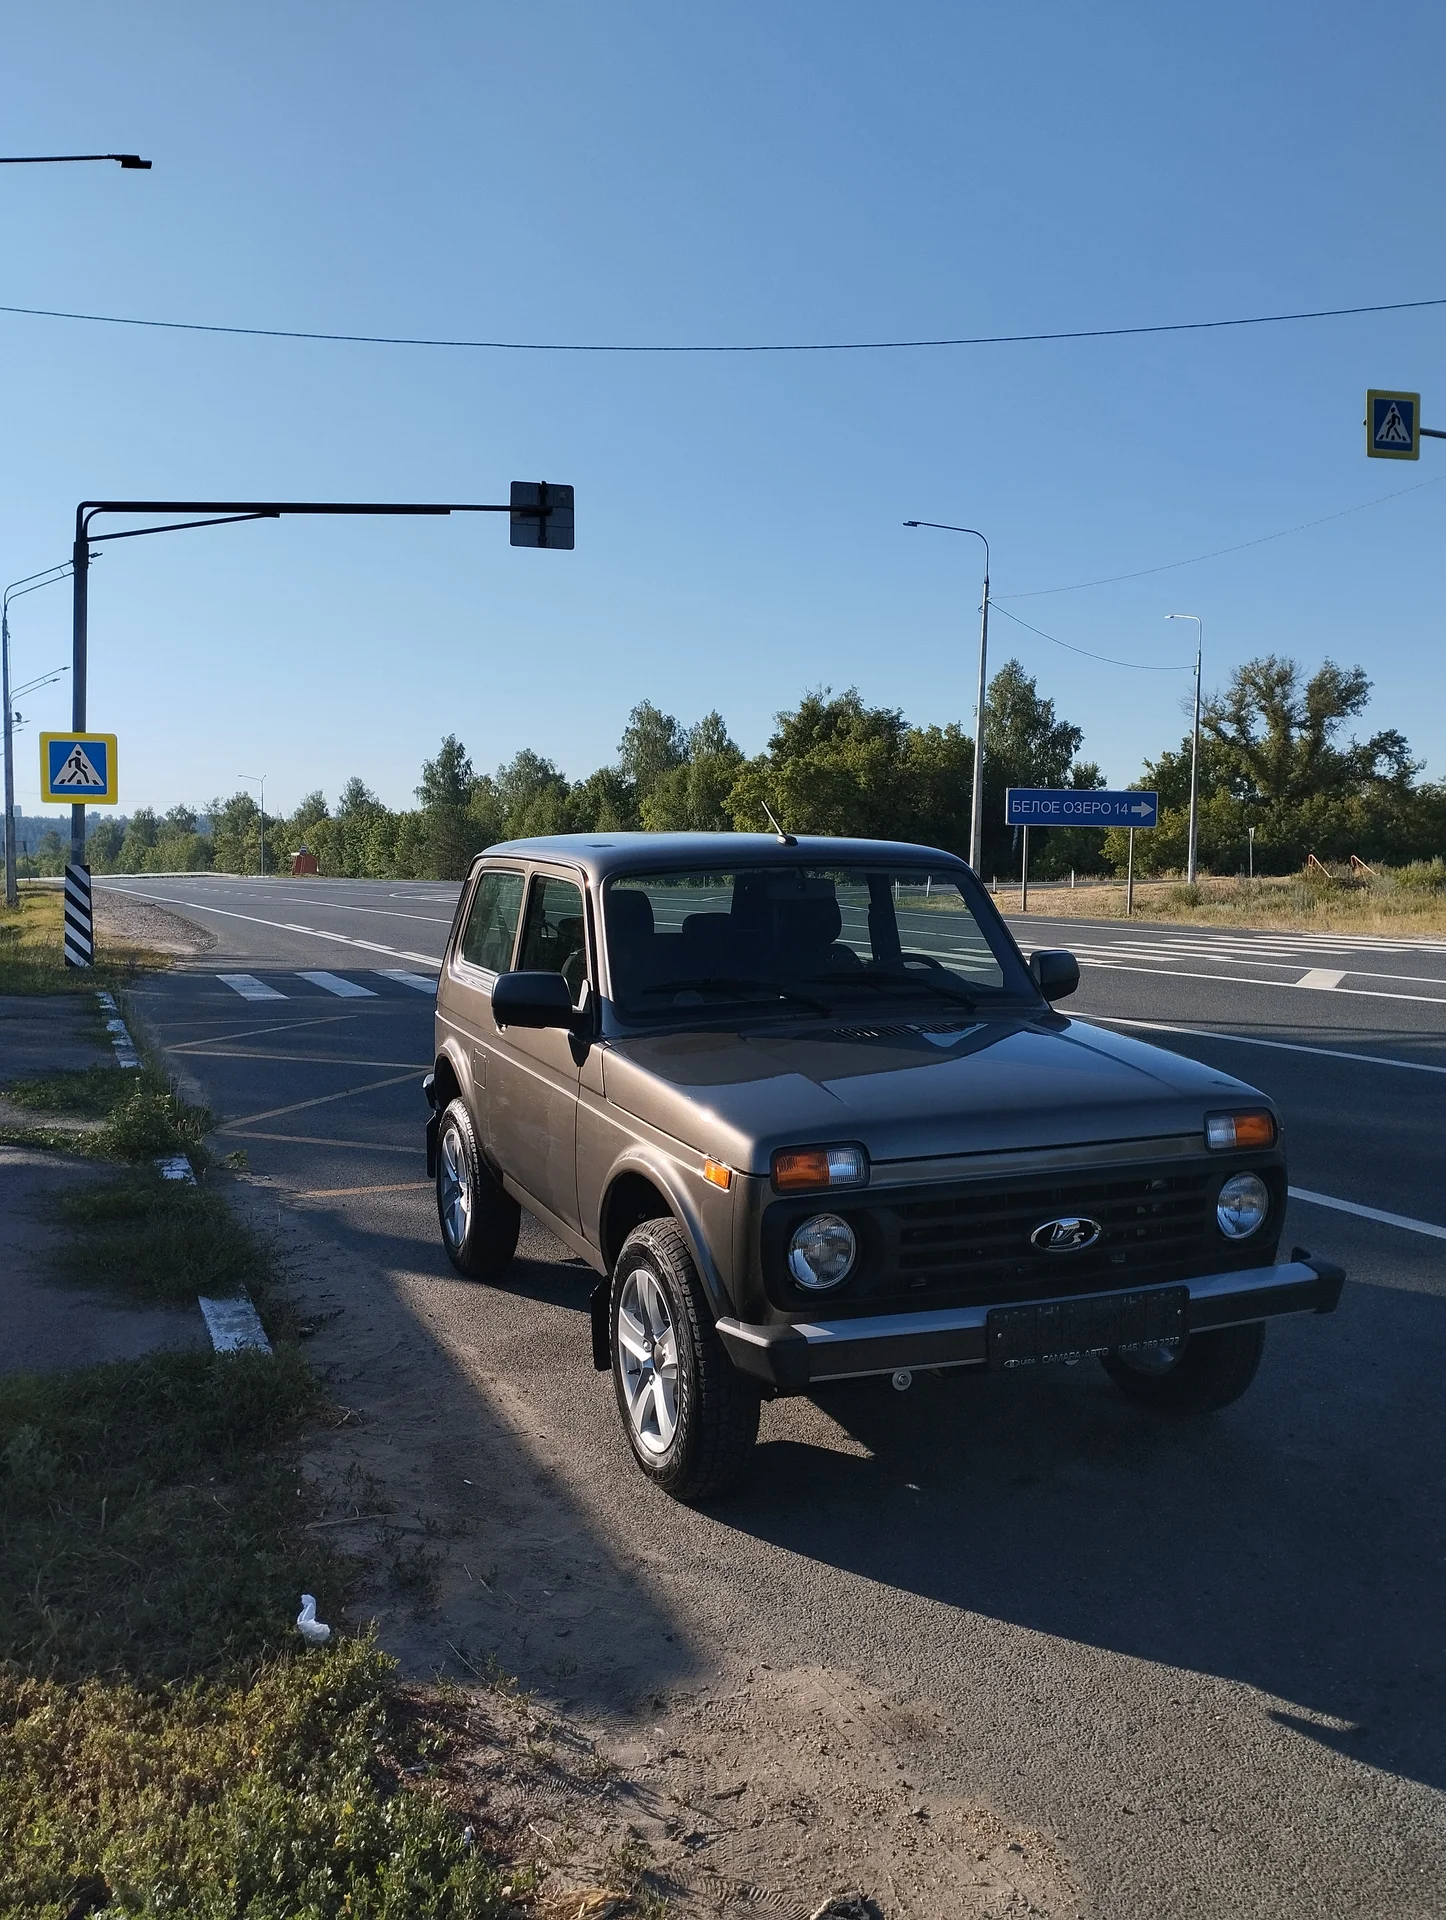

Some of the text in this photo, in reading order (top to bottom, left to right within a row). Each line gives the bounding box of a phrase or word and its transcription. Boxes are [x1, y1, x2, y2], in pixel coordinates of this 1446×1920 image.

[1012, 800, 1128, 815] БЕЛОЕ ОЗЕРО 14
[1042, 1347, 1109, 1364] САМАРА-АВТО
